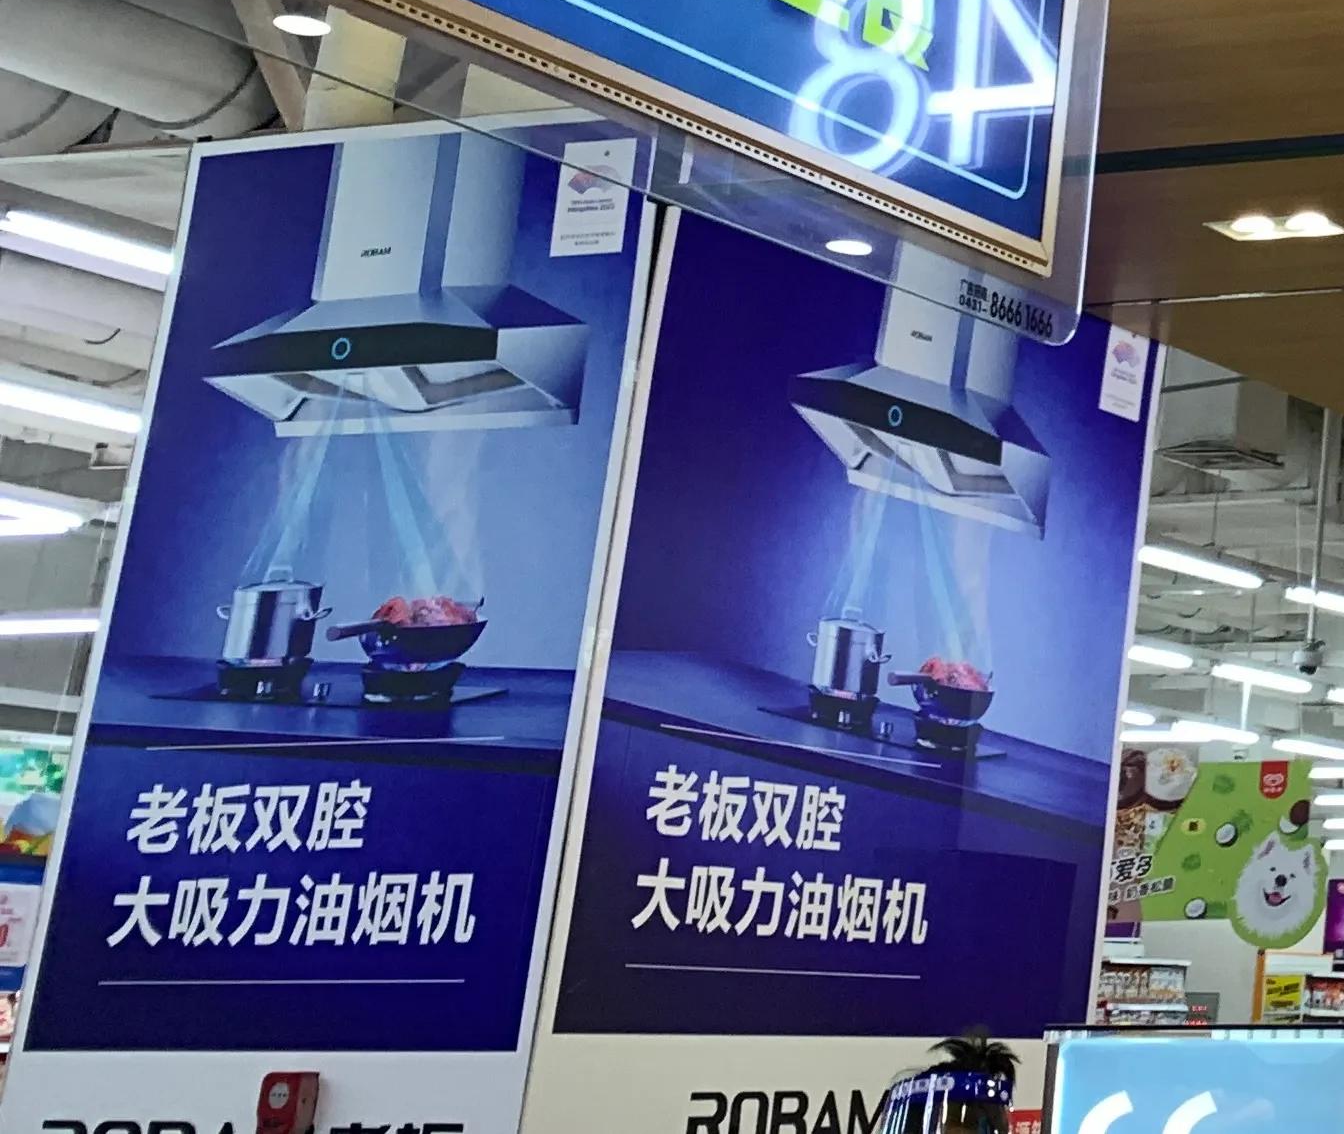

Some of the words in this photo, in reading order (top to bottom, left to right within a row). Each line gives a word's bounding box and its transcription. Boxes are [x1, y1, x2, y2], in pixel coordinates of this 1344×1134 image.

[126, 779, 373, 855] 老板双腔
[646, 763, 846, 852] 老板双腔
[105, 871, 477, 948] 大吸力油烟机
[632, 860, 929, 945] 大吸力油烟机
